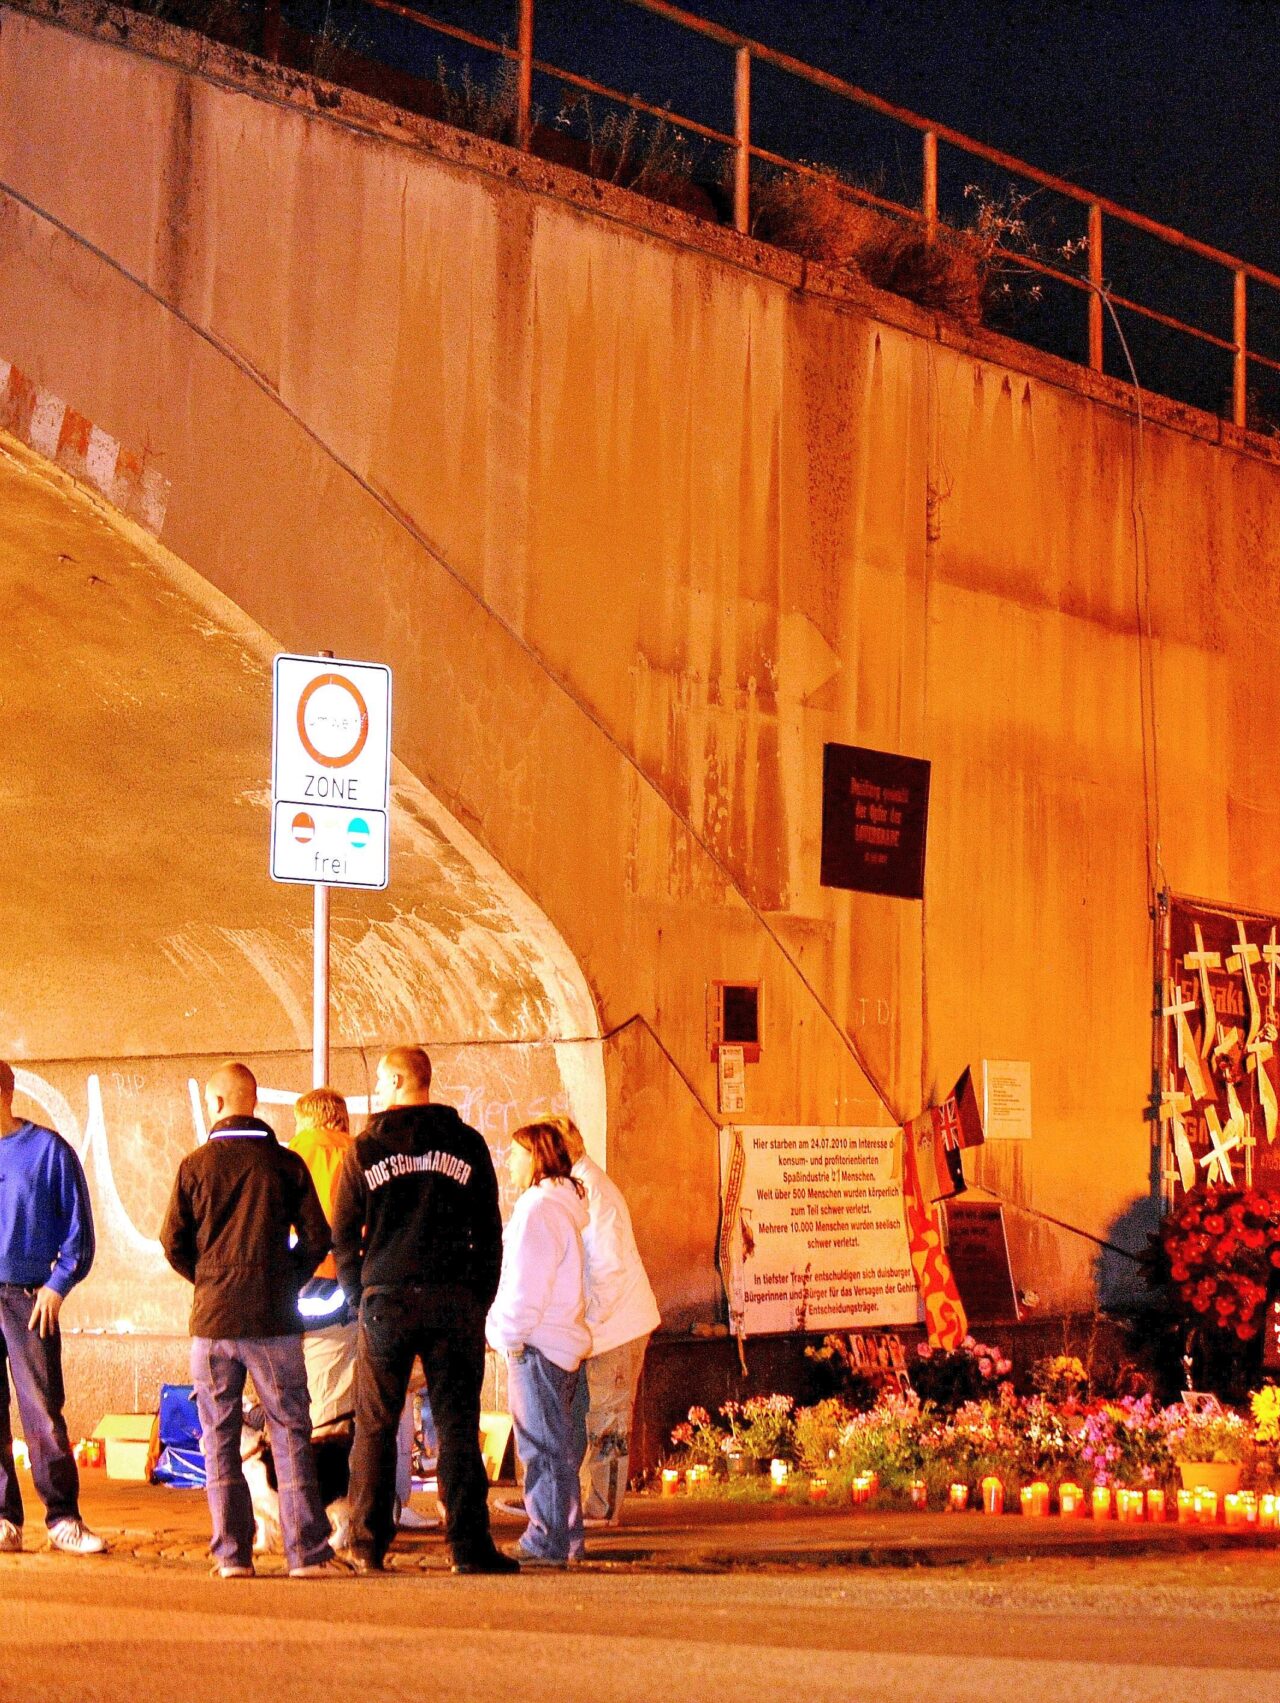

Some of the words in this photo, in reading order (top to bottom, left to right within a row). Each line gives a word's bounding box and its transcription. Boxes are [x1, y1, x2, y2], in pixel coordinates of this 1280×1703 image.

[304, 774, 359, 801] ZONE
[314, 851, 348, 875] frei
[753, 1138, 769, 1150] Hier
[769, 1138, 798, 1150] starben
[798, 1139, 810, 1150] am
[811, 1137, 848, 1150] 24.07.2010
[849, 1138, 858, 1149] im
[858, 1137, 888, 1149] Interesse
[778, 1154, 809, 1166] konsum-
[810, 1154, 823, 1166] und
[824, 1153, 879, 1168] profitorientierten
[782, 1170, 830, 1185] Spaßindustrie
[841, 1169, 876, 1182] Menschen.
[756, 1188, 774, 1201] Weit
[774, 1187, 792, 1201] über
[792, 1187, 806, 1200] 500
[807, 1187, 842, 1199] Menschen
[843, 1187, 867, 1199] wurden
[868, 1185, 900, 1201] körperlich
[790, 1206, 806, 1217] zum
[807, 1204, 819, 1216] Teil
[820, 1203, 846, 1216] schwer
[846, 1202, 872, 1215] verletzt.
[758, 1222, 789, 1234] Mehrere
[790, 1221, 814, 1233] 10.000
[815, 1219, 850, 1232] Menschen
[850, 1219, 874, 1231] wurden
[875, 1217, 901, 1230] seelisch
[807, 1237, 832, 1250] schwer
[833, 1236, 860, 1248] verletzt.
[754, 1273, 762, 1286] In
[763, 1272, 789, 1285] tiefster
[814, 1269, 861, 1283] entschuldigen
[862, 1267, 876, 1280] sich
[877, 1266, 911, 1280] duisburger
[744, 1290, 788, 1305] Bürgerinnen
[789, 1289, 803, 1301] und
[803, 1287, 828, 1301] Bürger
[829, 1285, 839, 1298] für
[840, 1284, 853, 1297] das
[853, 1283, 884, 1298] Versagen
[885, 1282, 896, 1295] der
[808, 1301, 880, 1317] Entscheidungsträger.
